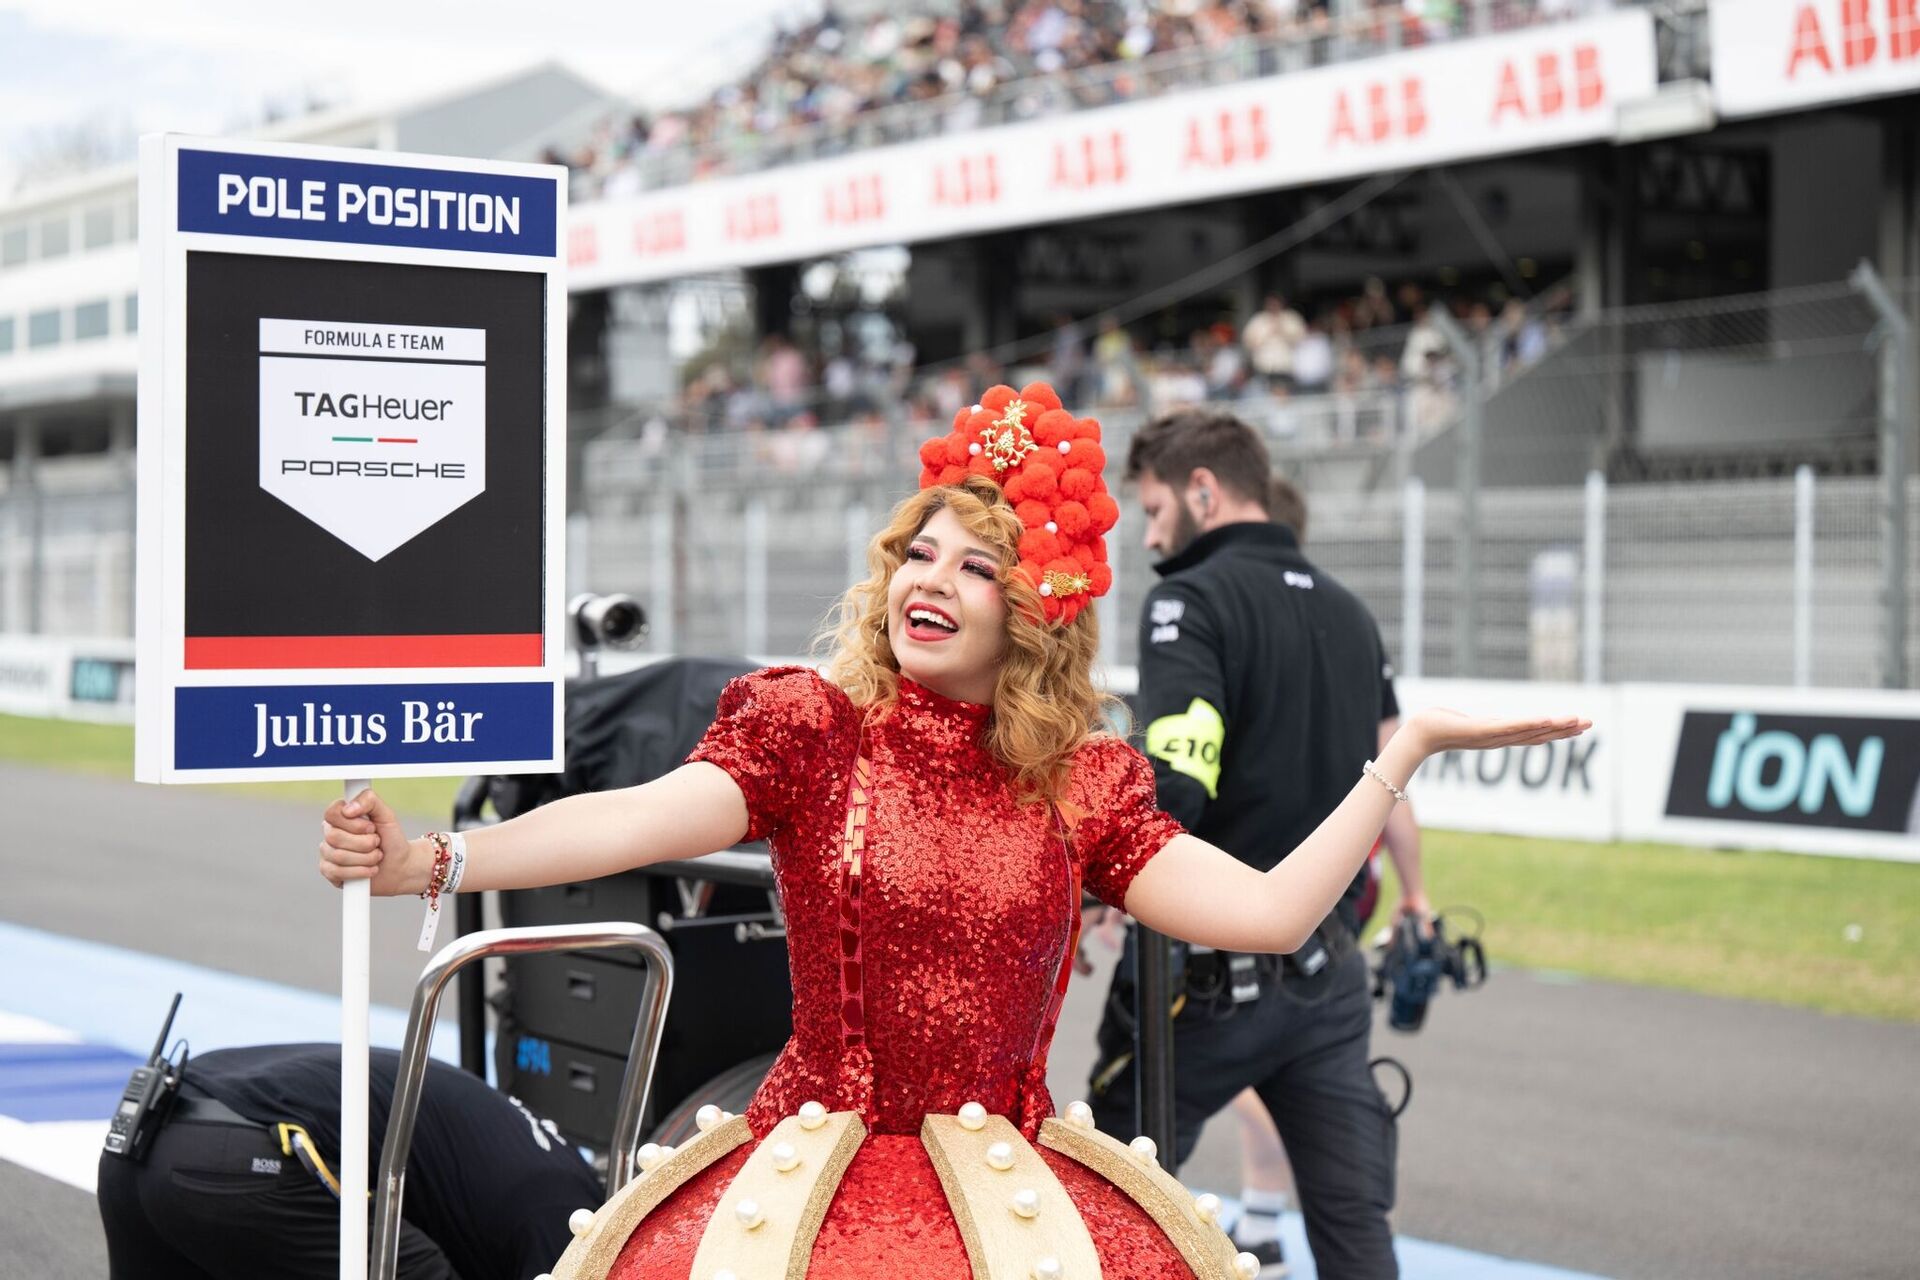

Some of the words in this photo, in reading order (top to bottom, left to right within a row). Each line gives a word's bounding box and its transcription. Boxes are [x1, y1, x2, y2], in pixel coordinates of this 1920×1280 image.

[1784, 0, 1920, 81] ABB
[1182, 102, 1273, 170] ABB
[1328, 74, 1431, 147] ABB
[1490, 42, 1607, 124] ABB
[218, 173, 326, 222] POLE
[338, 182, 520, 235] POSITION
[304, 329, 383, 348] FORMULA
[387, 333, 396, 349] E
[400, 334, 444, 351] TEAM
[281, 459, 465, 479] PORSCHE
[252, 702, 387, 758] Julius
[401, 701, 484, 744] Bär
